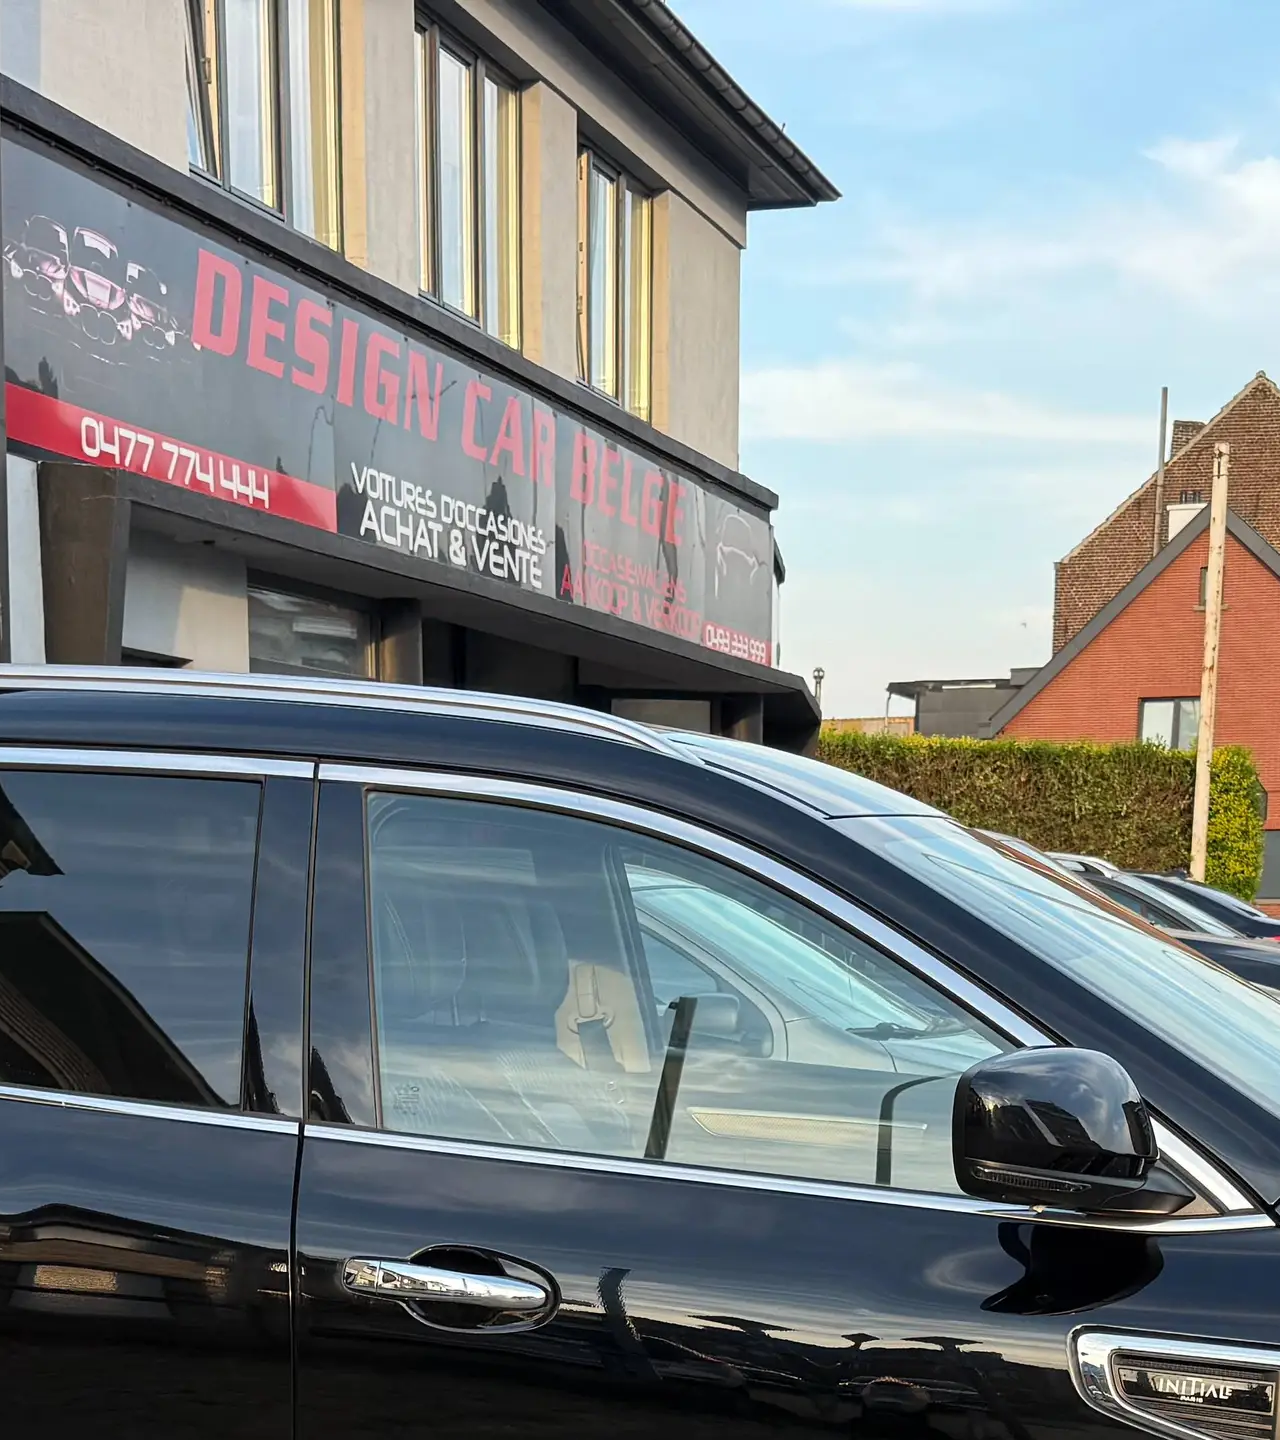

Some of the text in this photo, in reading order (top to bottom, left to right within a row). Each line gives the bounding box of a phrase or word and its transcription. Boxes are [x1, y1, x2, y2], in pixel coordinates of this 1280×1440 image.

[191, 247, 687, 547] DESIGN CAR BELGE
[81, 416, 270, 510] 0477 774 444
[351, 461, 546, 555] VOITURES D'OCCASIONES
[360, 500, 543, 589] ACHAT & VENTE
[560, 563, 628, 616] AANKOOP
[705, 624, 730, 654] 0493
[1158, 1376, 1233, 1400] INITIALE
